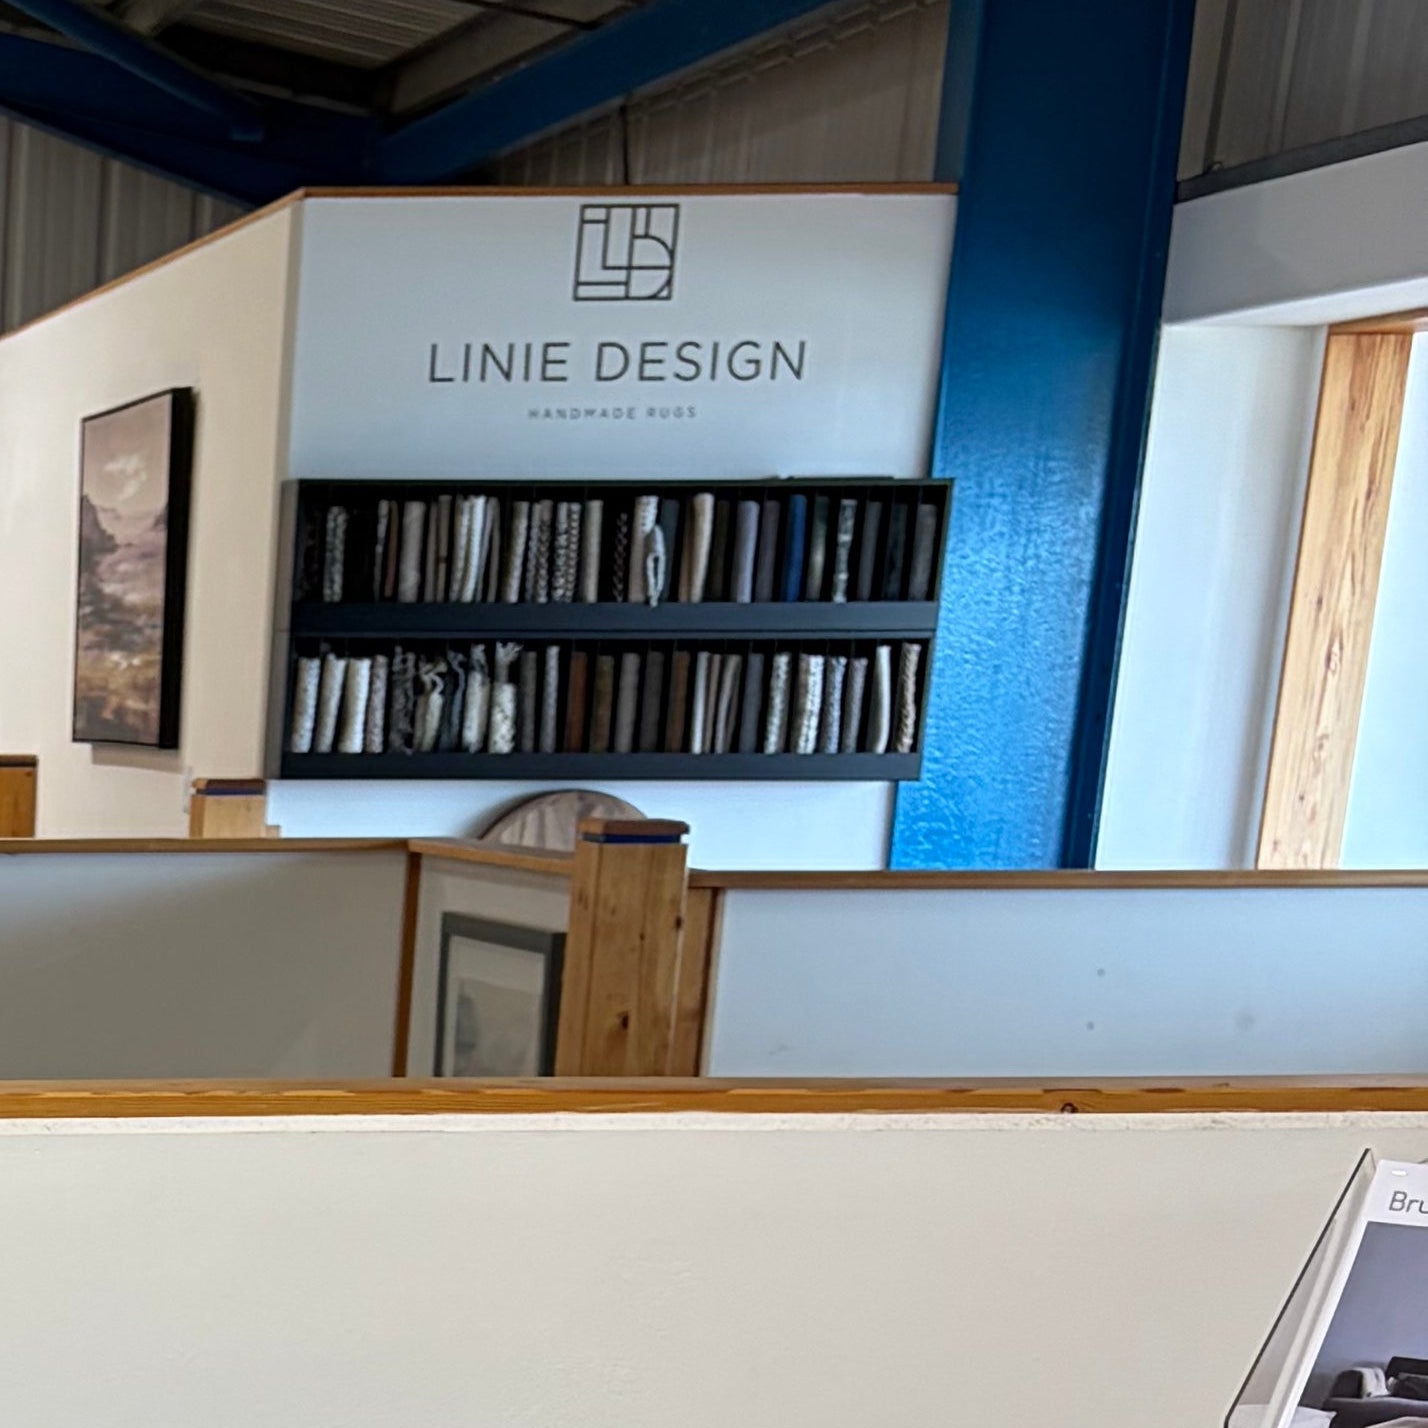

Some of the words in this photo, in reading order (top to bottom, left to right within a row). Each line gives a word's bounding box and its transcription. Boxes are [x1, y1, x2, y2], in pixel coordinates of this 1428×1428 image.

[428, 341, 571, 383] LINIE
[595, 339, 807, 383] DESIGN
[527, 406, 635, 420] HANDMADE
[646, 404, 697, 419] RUGS
